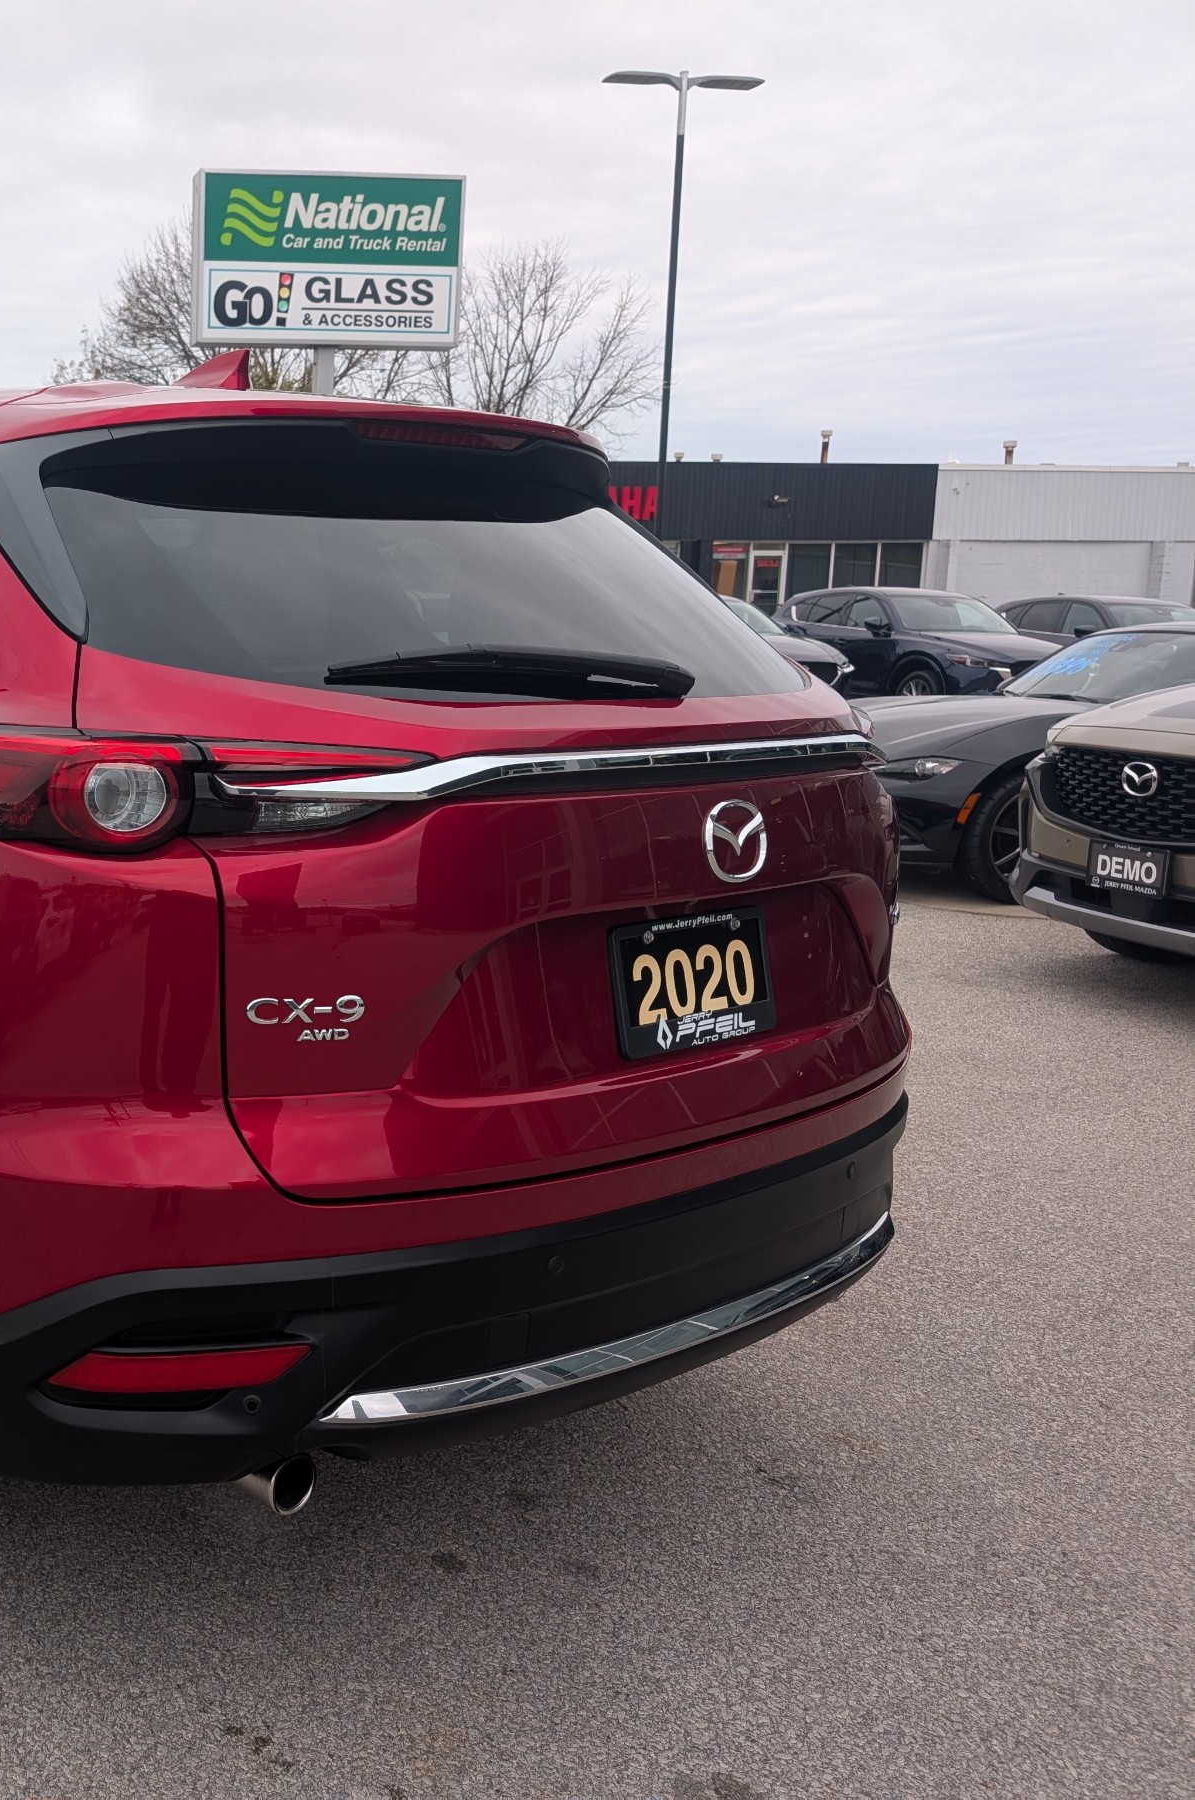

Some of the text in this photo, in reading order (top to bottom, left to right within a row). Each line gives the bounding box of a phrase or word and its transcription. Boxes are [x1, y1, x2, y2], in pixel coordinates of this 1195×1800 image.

[284, 192, 446, 232] National
[282, 233, 446, 252] Car and Truck Rental
[304, 276, 434, 306] GLASS
[302, 314, 433, 329] & ACCESSORIES
[1096, 853, 1157, 884] DEMO
[1104, 880, 1119, 888] JERRY
[1120, 882, 1134, 891] PFEIL
[1134, 886, 1157, 896] MAZDA
[651, 913, 733, 932] www.JerryPfeil.com
[632, 939, 755, 1026] 2020
[246, 994, 366, 1025] CX-9
[677, 1010, 713, 1025] JERRY
[296, 1028, 350, 1042] AWD
[675, 1011, 756, 1043] PFEIL
[691, 1026, 756, 1046] AUTO GROUP
